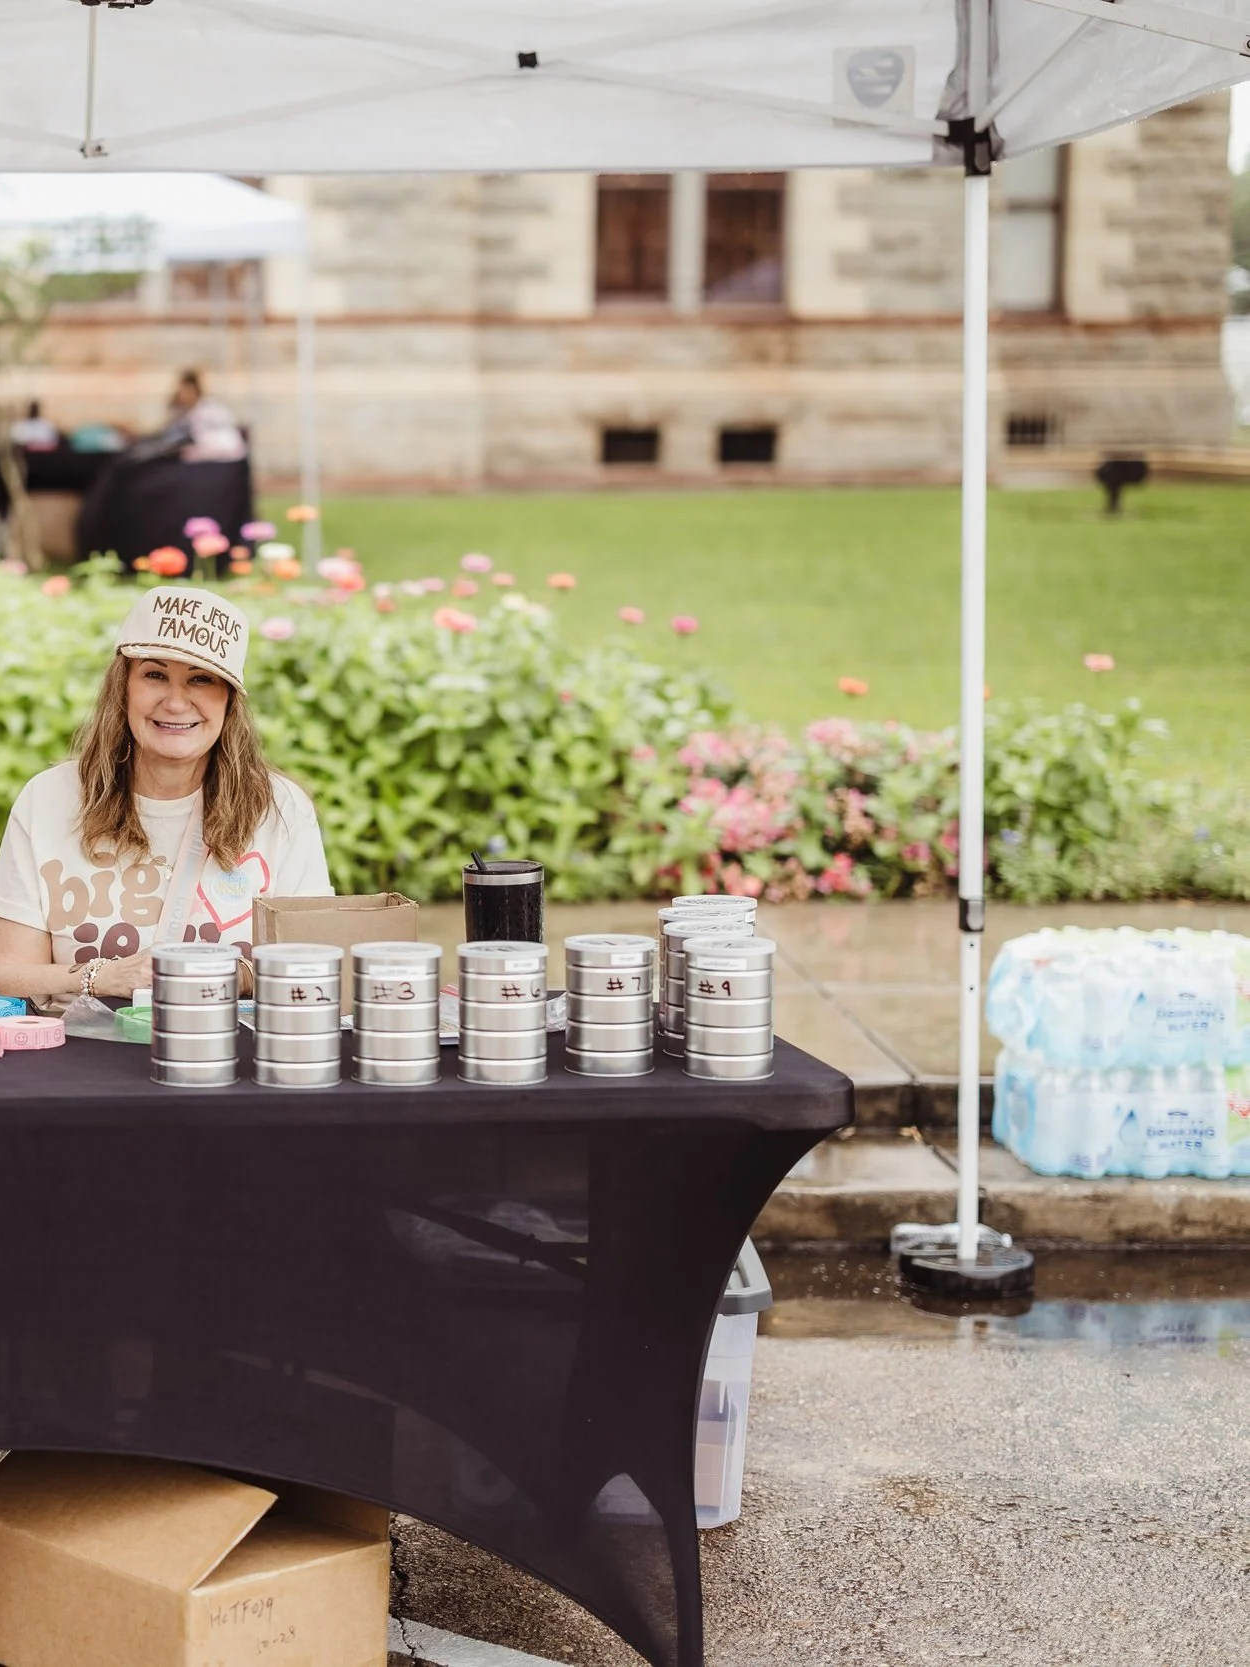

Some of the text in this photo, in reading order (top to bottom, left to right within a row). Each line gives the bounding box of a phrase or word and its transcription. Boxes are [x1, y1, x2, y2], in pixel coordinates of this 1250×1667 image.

[153, 595, 242, 642] MAKE JESUS
[157, 616, 230, 659] FAMOUS
[39, 852, 167, 932] big
